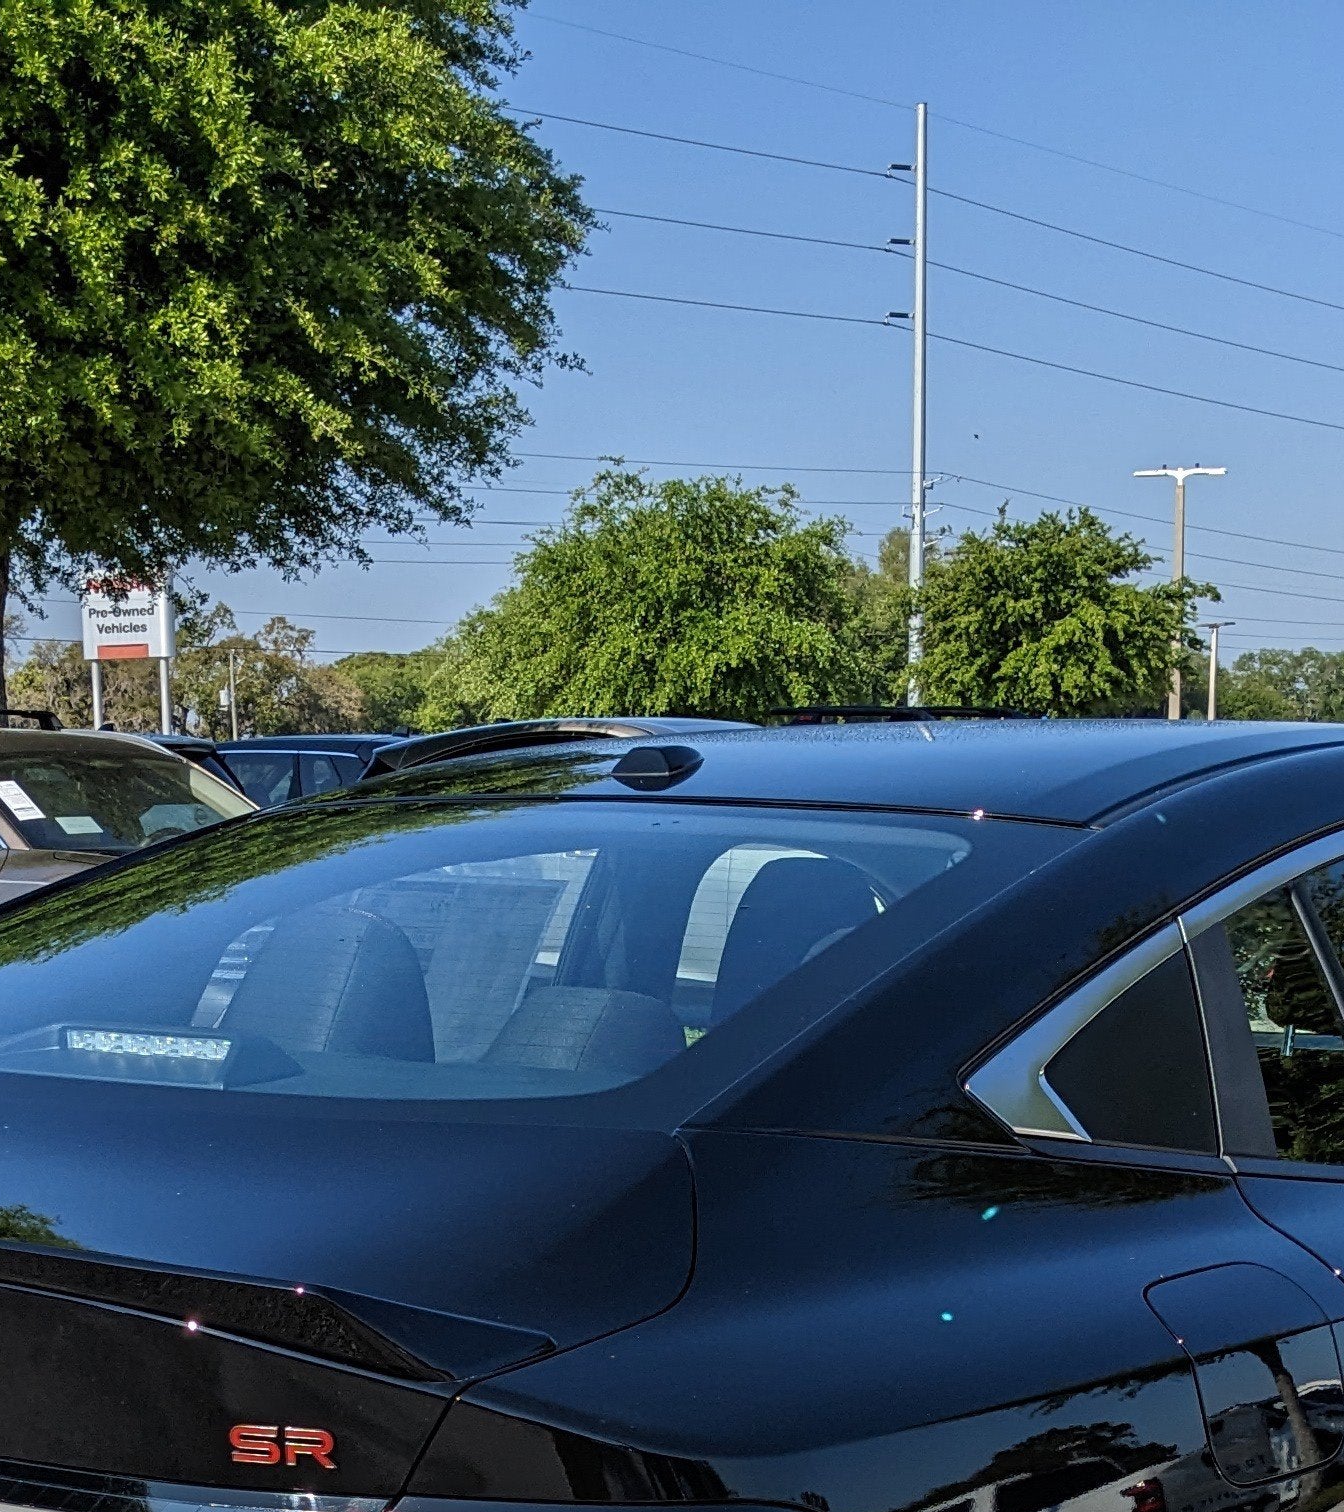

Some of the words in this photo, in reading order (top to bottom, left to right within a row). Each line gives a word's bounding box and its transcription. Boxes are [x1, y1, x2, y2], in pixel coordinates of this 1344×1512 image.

[88, 605, 155, 619] Pre-Owned
[96, 622, 148, 635] Vehicles
[229, 1424, 337, 1469] SR
